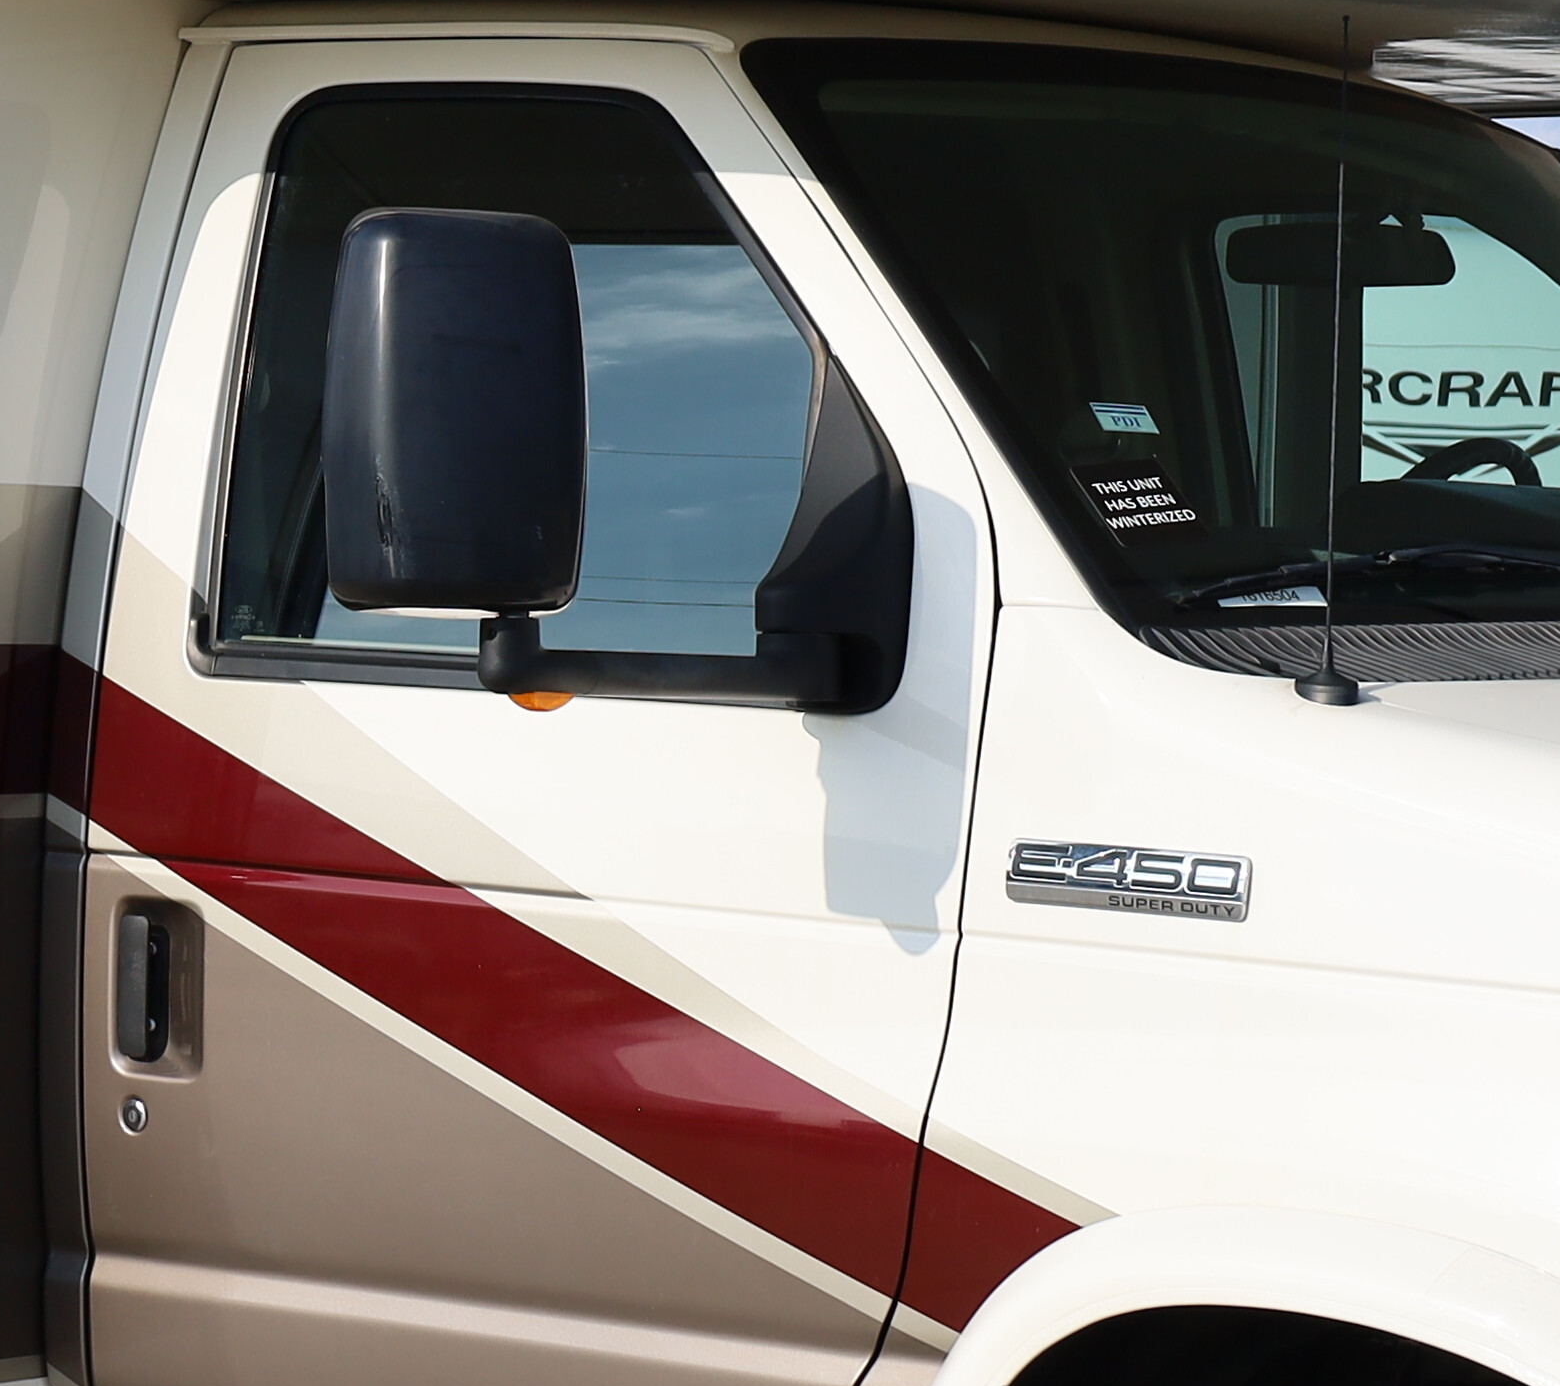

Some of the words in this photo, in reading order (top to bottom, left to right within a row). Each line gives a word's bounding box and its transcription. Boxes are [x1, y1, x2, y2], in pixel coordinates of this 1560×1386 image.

[1111, 415, 1142, 428] PDI
[1091, 480, 1128, 496] THIS
[1126, 476, 1164, 492] UNIT
[1103, 497, 1137, 512] HAS
[1135, 493, 1177, 509] BEEN
[1105, 509, 1197, 530] WINTERIZED
[1009, 842, 1243, 897] E-450
[1108, 894, 1175, 912] SUPER
[1180, 901, 1236, 917] DUTY
